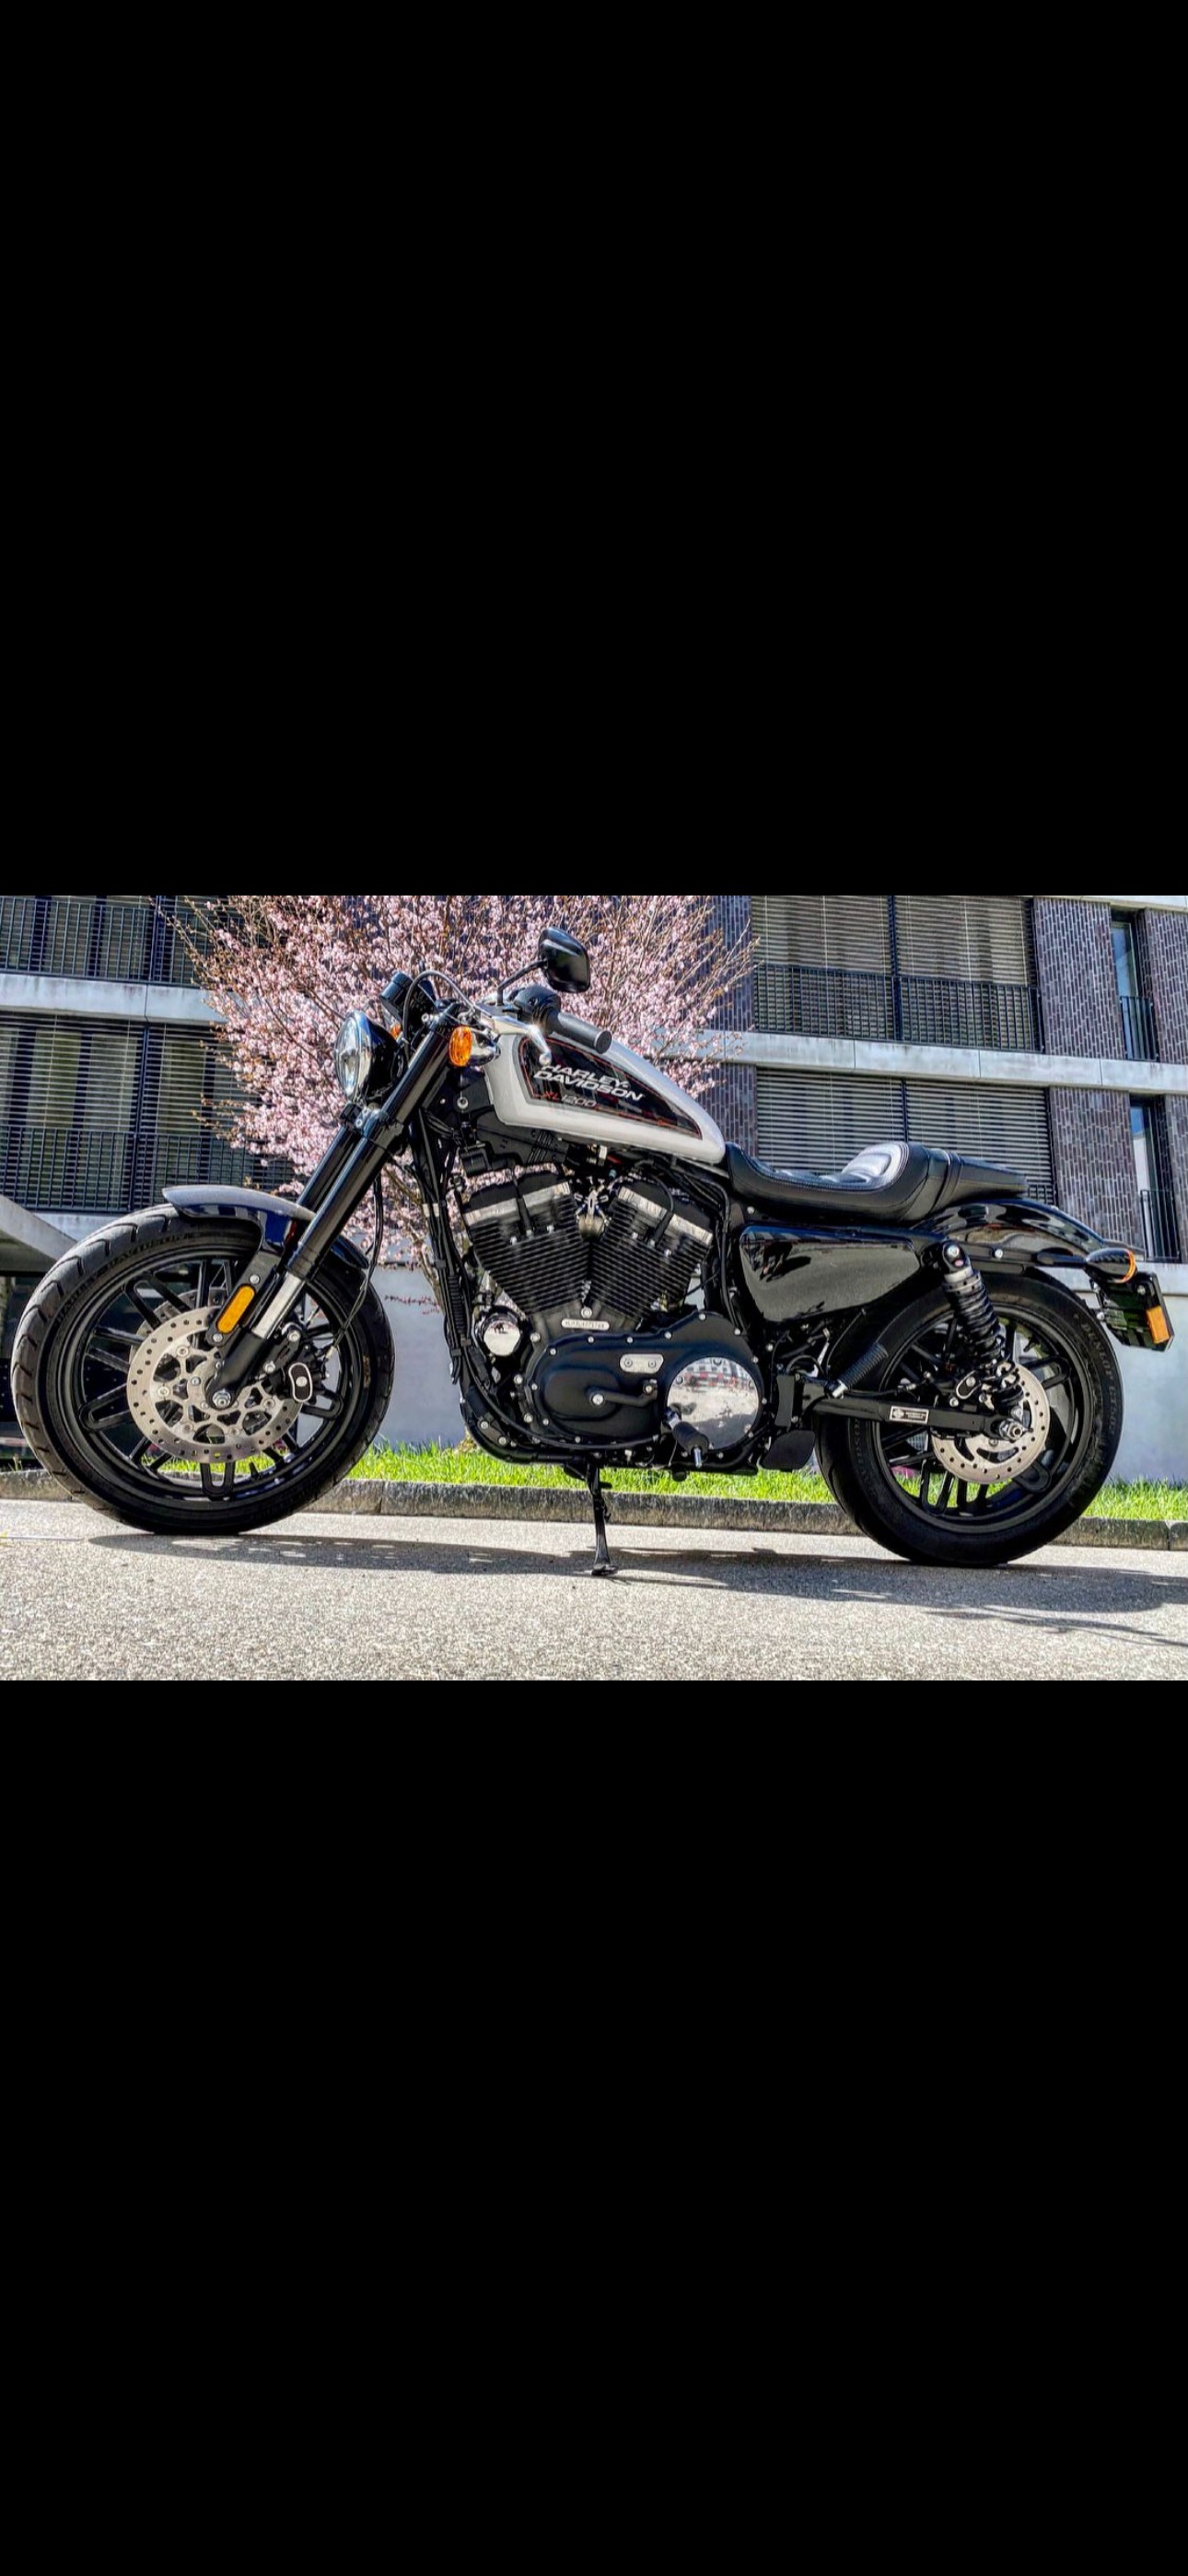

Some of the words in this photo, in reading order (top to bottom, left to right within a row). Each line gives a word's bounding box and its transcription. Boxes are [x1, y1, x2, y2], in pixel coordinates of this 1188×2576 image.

[533, 1071, 644, 1101] DAVIDSON
[561, 1095, 598, 1107] 1200
[1080, 1322, 1114, 1380] DUNLOP
